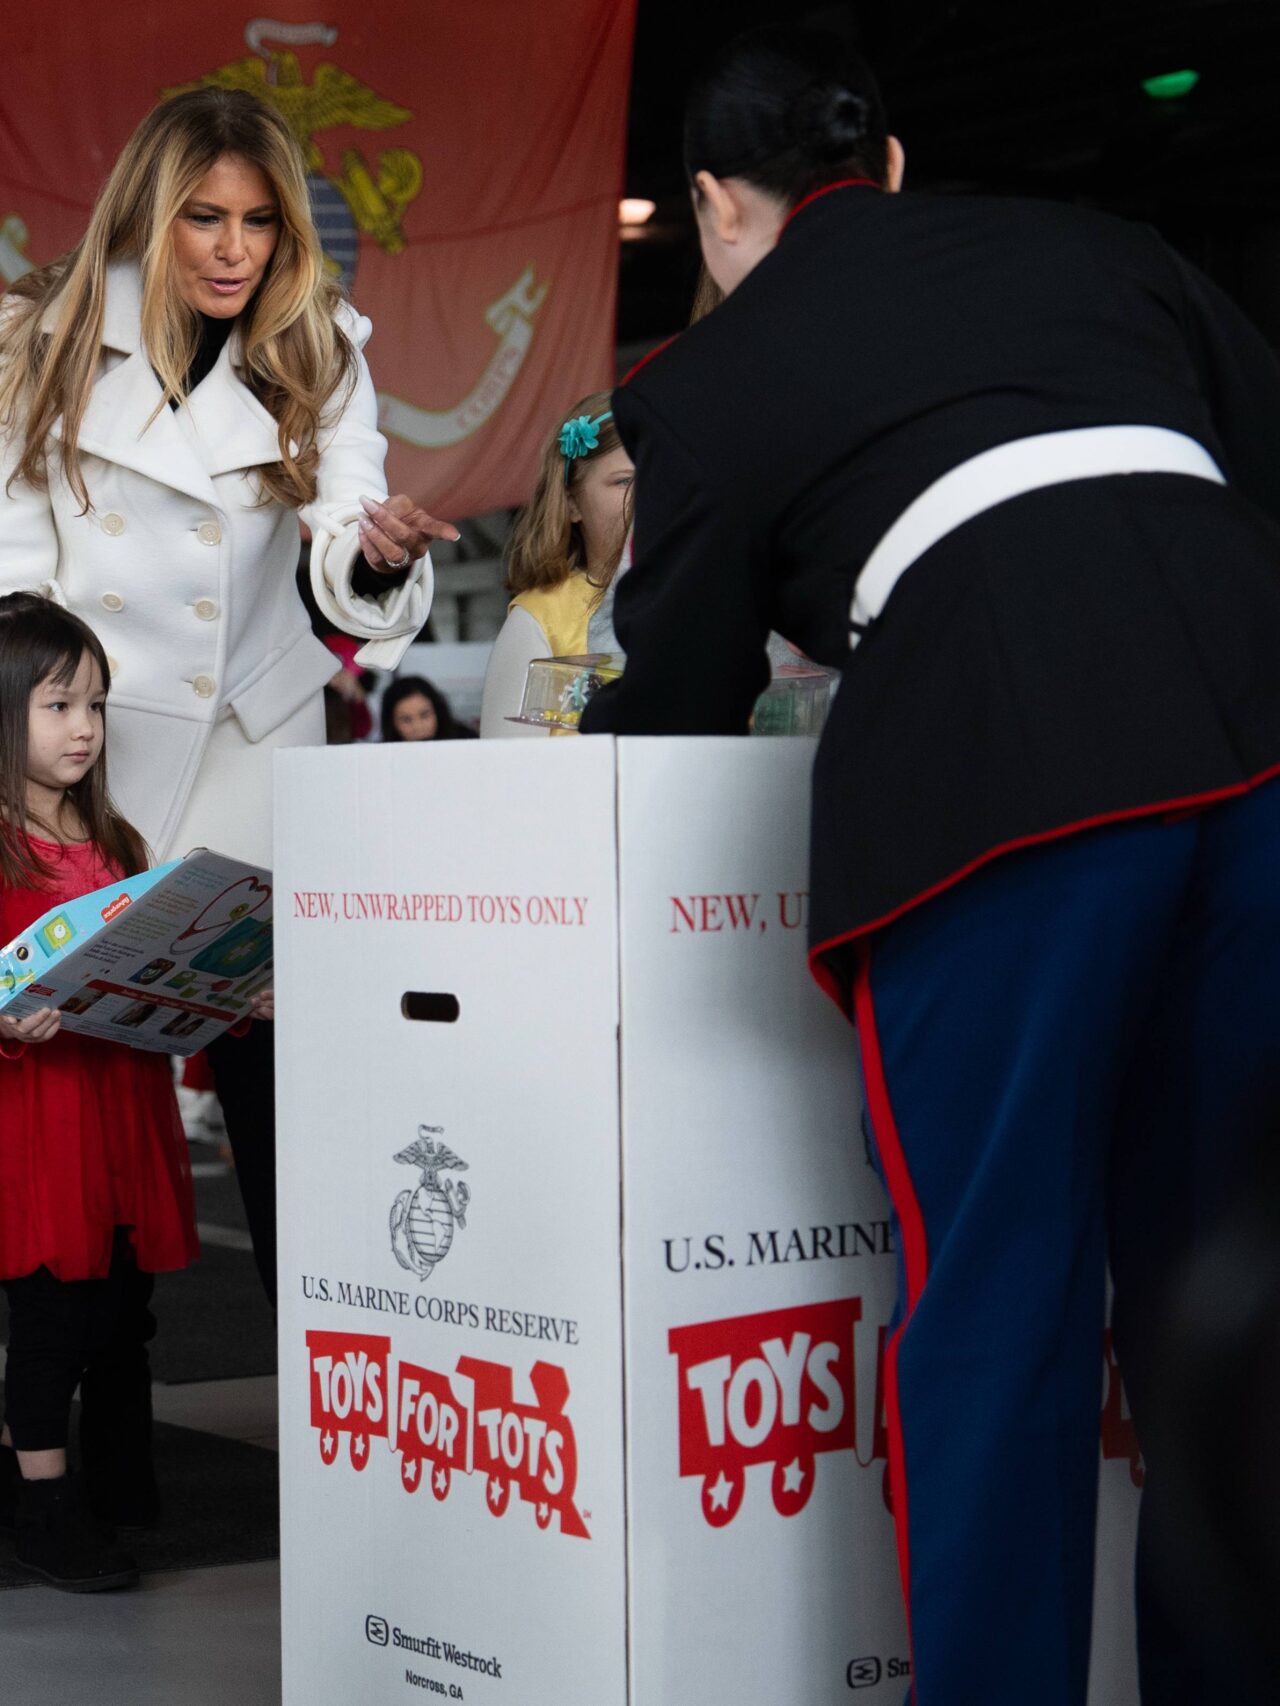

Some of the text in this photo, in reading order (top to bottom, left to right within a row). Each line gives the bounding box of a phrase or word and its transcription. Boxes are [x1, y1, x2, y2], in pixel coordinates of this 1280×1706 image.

[293, 892, 589, 926] NEW, UNWRAPPED TOYS ONLY
[669, 894, 767, 935] NEW,
[663, 1234, 735, 1273] U.S.
[302, 1275, 580, 1346] U.S. MARINE CORPS RESERVE
[687, 1331, 845, 1448] TOYS
[313, 1351, 564, 1495] TOYS FOR TOTS
[393, 1627, 503, 1679] Smurfit Westrock
[405, 1669, 464, 1700] Norcross, GA
